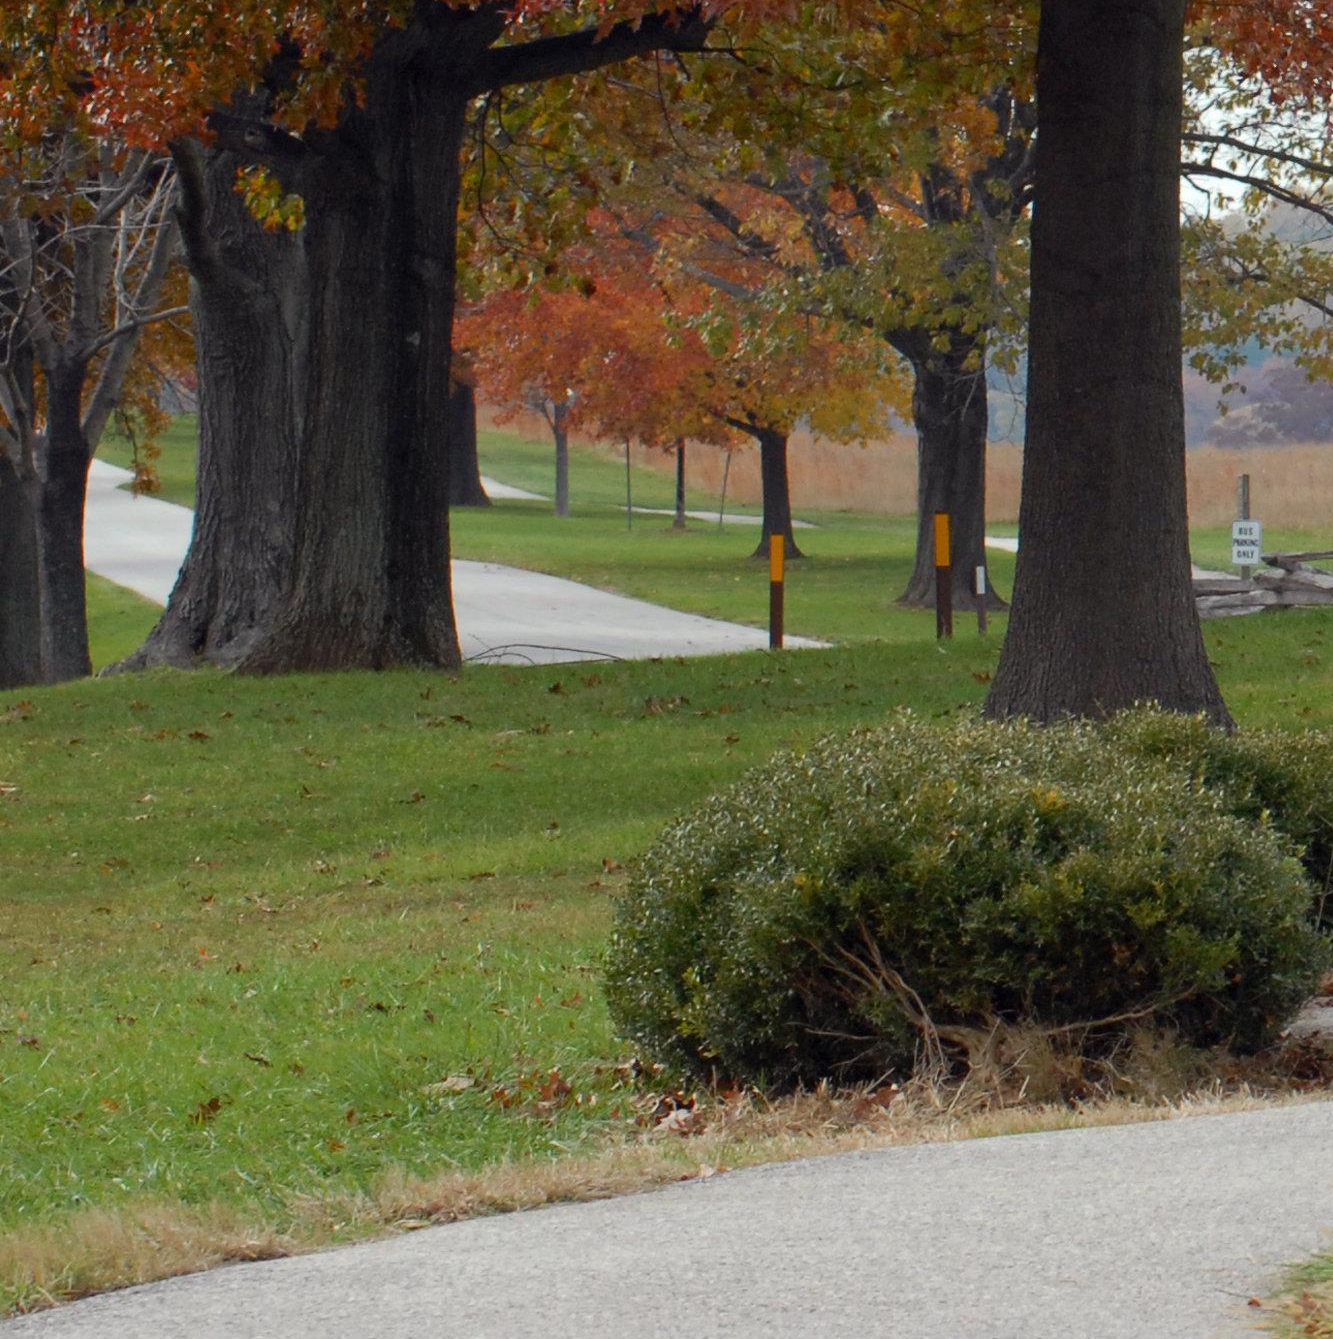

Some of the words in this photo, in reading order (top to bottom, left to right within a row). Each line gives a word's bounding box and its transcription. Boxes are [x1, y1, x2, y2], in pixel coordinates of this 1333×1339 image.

[1239, 527, 1253, 535] BUS
[1233, 538, 1258, 546] PARKING
[1237, 550, 1254, 558] ONLY
